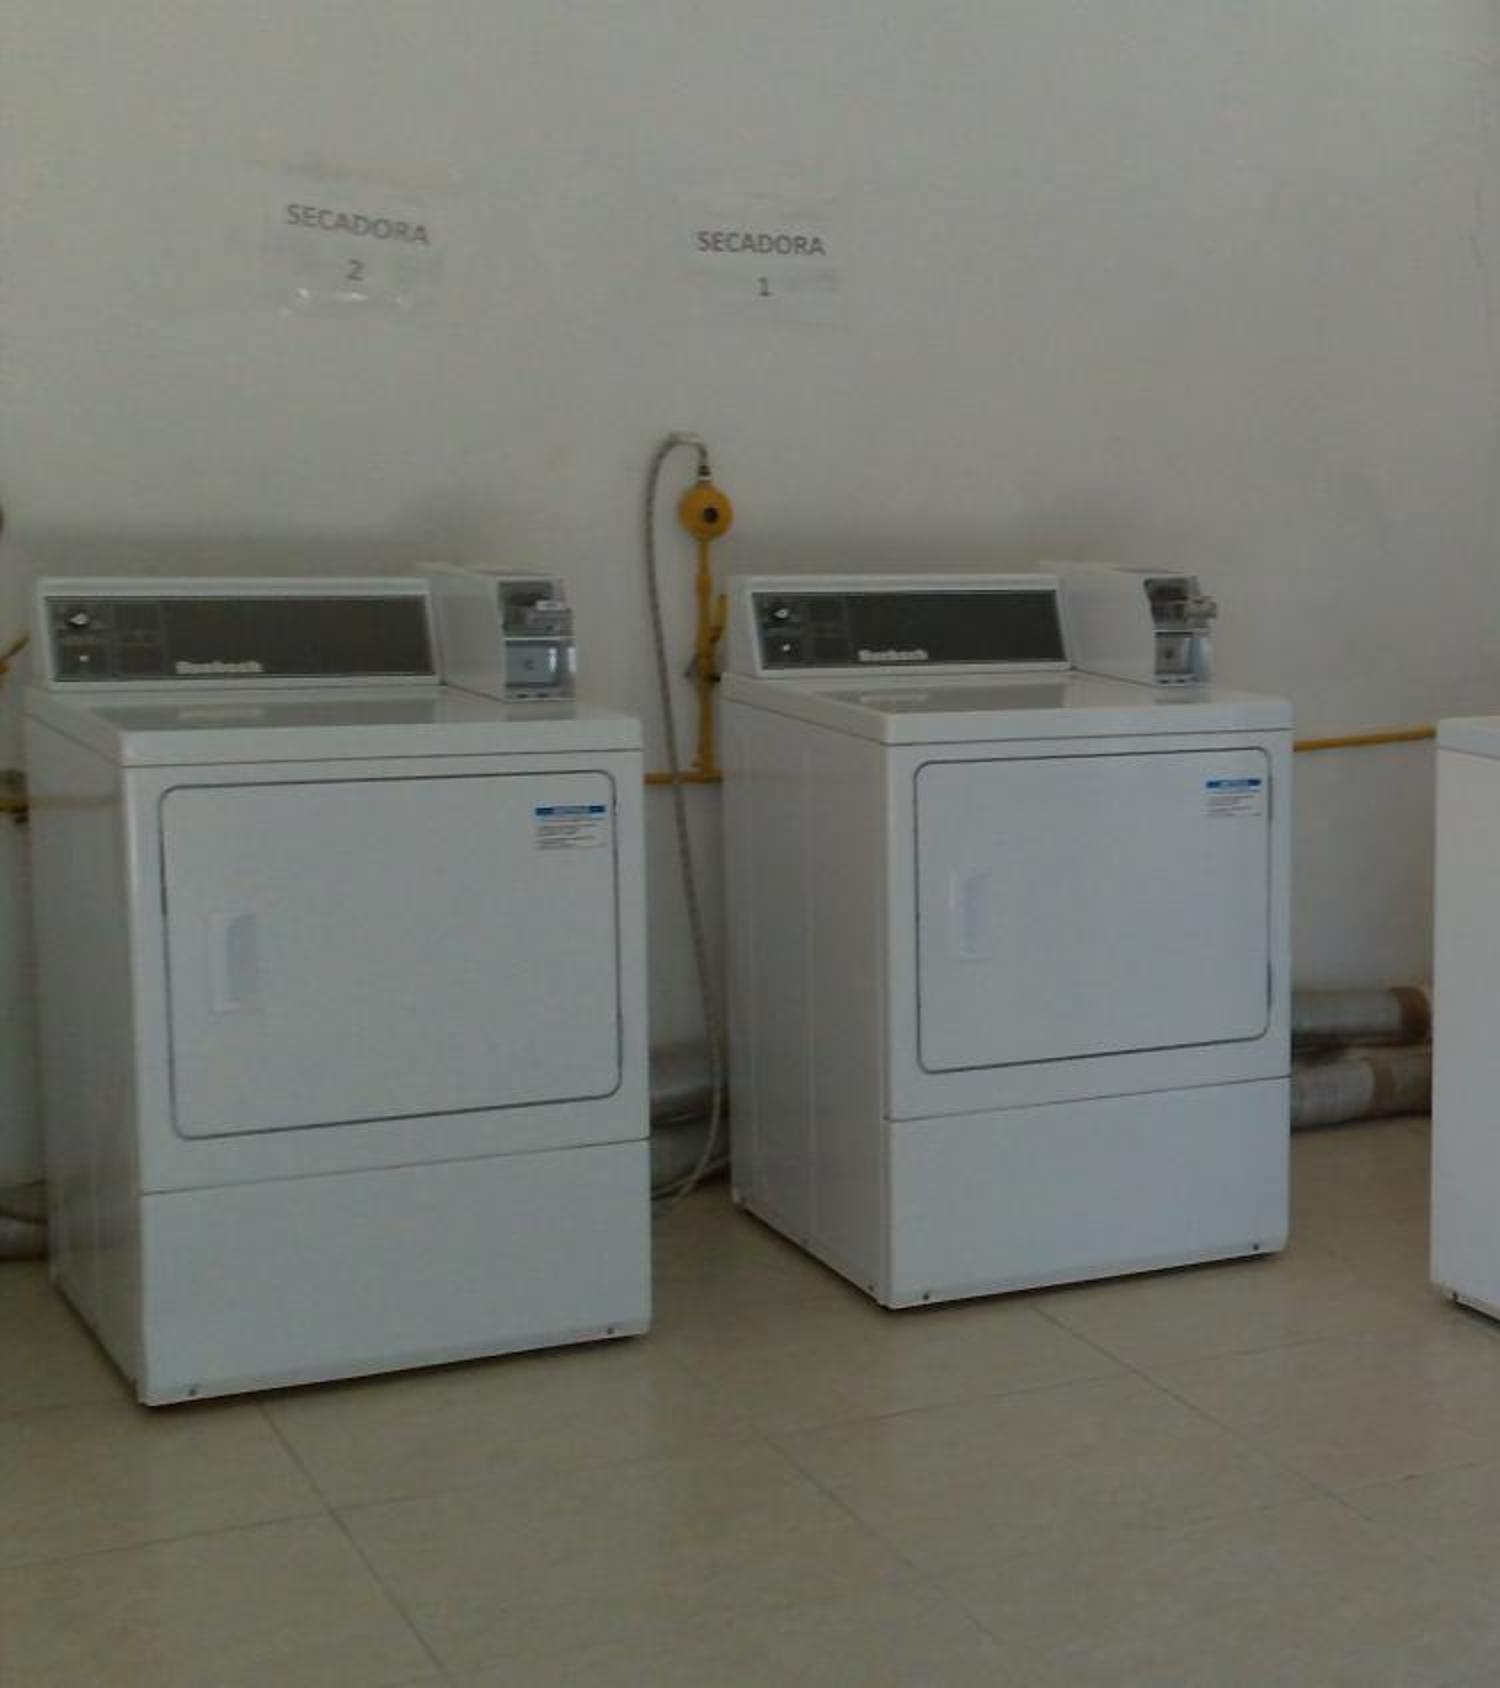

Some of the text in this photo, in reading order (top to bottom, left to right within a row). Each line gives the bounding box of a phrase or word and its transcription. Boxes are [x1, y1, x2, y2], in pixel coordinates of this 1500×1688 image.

[286, 203, 431, 246] SECADORA
[697, 231, 826, 256] SECADORA
[346, 258, 364, 281] 2
[757, 276, 774, 296] 1
